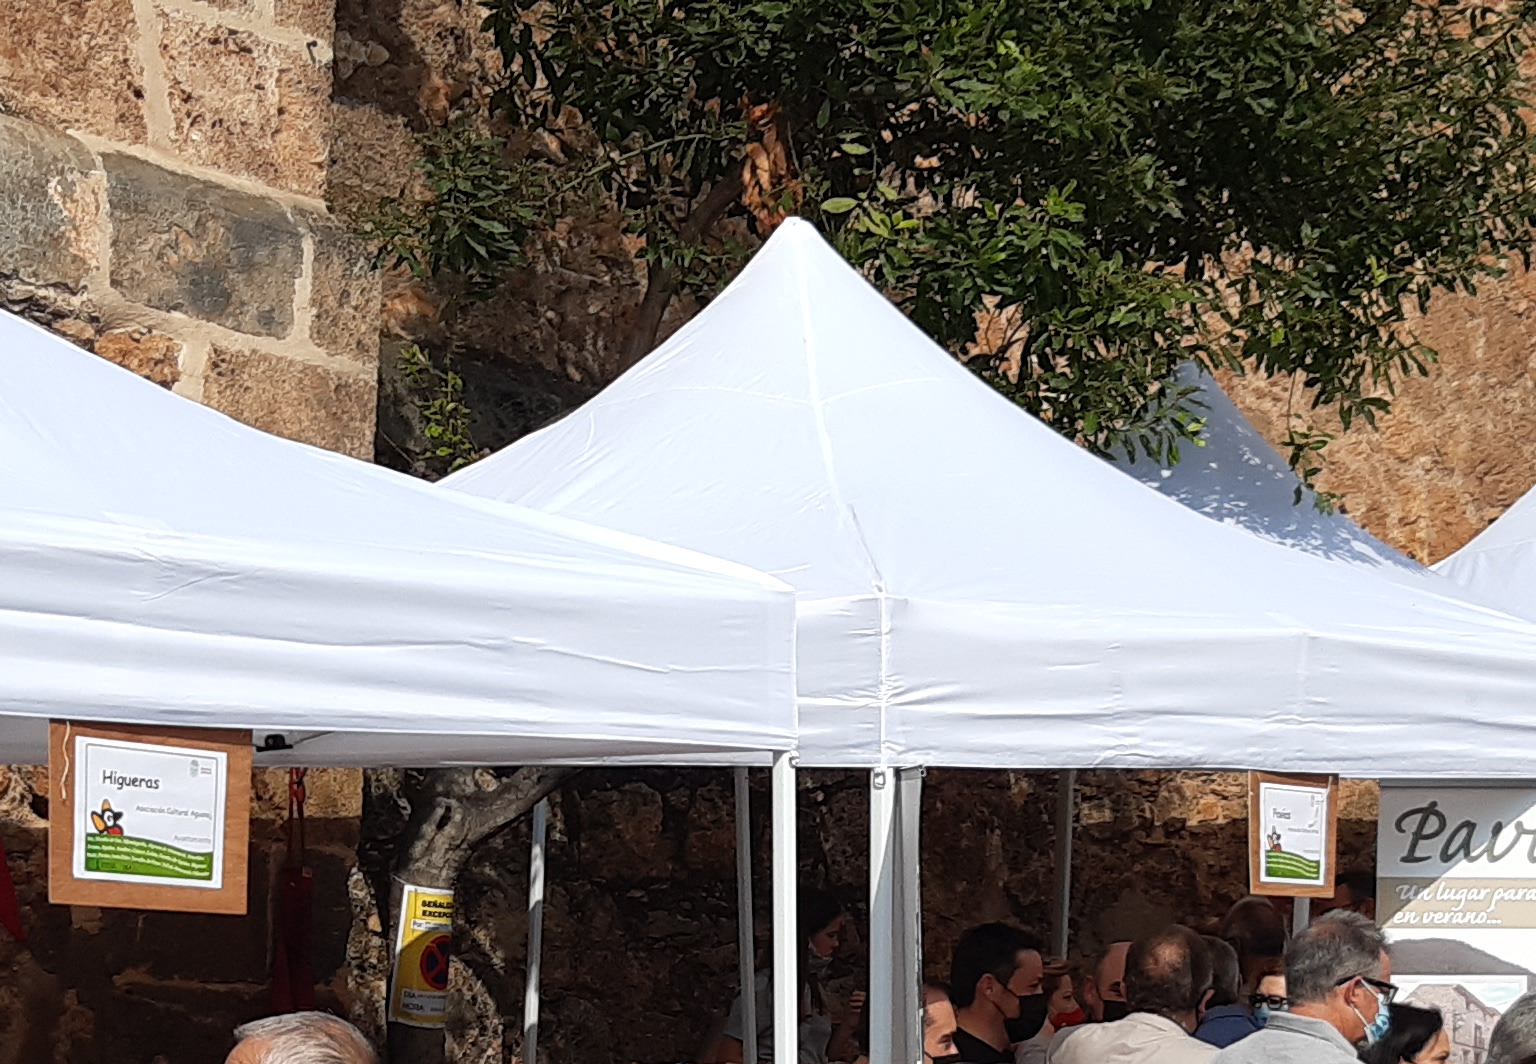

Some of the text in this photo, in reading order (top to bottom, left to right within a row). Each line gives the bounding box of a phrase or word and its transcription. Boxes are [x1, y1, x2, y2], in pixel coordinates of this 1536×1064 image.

[102, 769, 161, 790] Higueras
[1395, 883, 1432, 901] Un
[1435, 881, 1488, 912] lugar
[1392, 908, 1503, 925] en verano...
